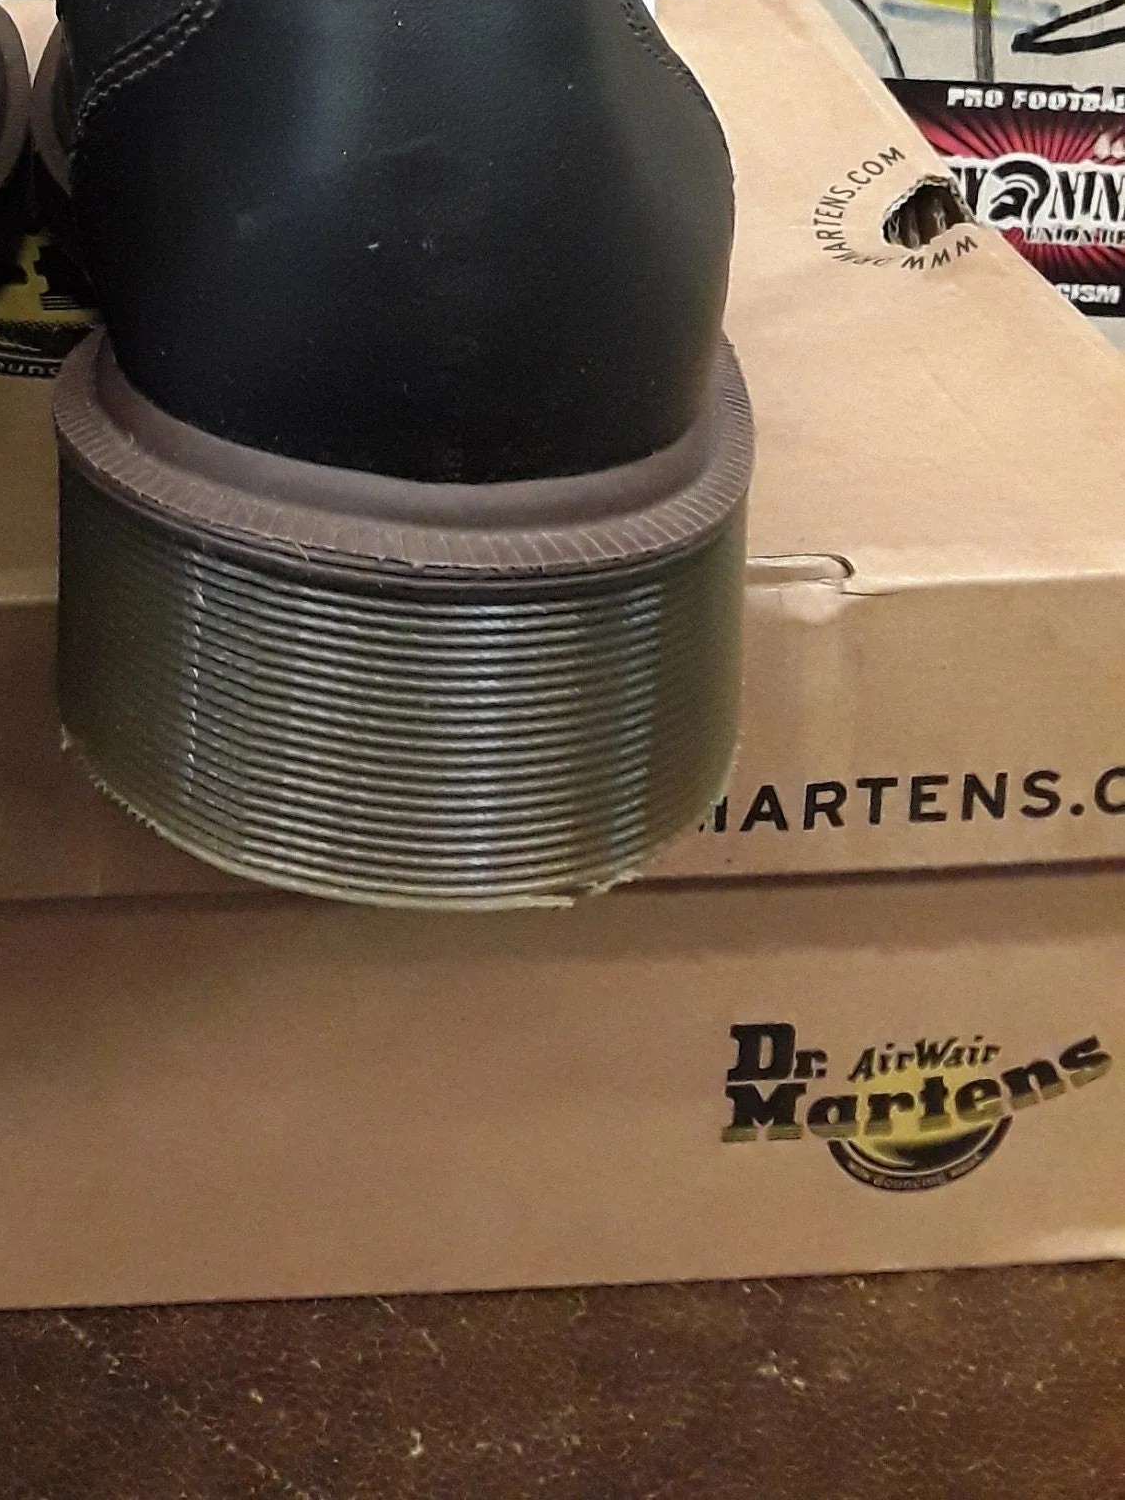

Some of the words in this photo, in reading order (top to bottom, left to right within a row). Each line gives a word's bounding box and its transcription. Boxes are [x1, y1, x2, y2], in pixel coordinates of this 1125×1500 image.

[947, 87, 1005, 109] PRO
[727, 1022, 828, 1080] Dr.
[847, 1034, 1003, 1083] AirWair
[721, 1034, 1113, 1143] Martens
